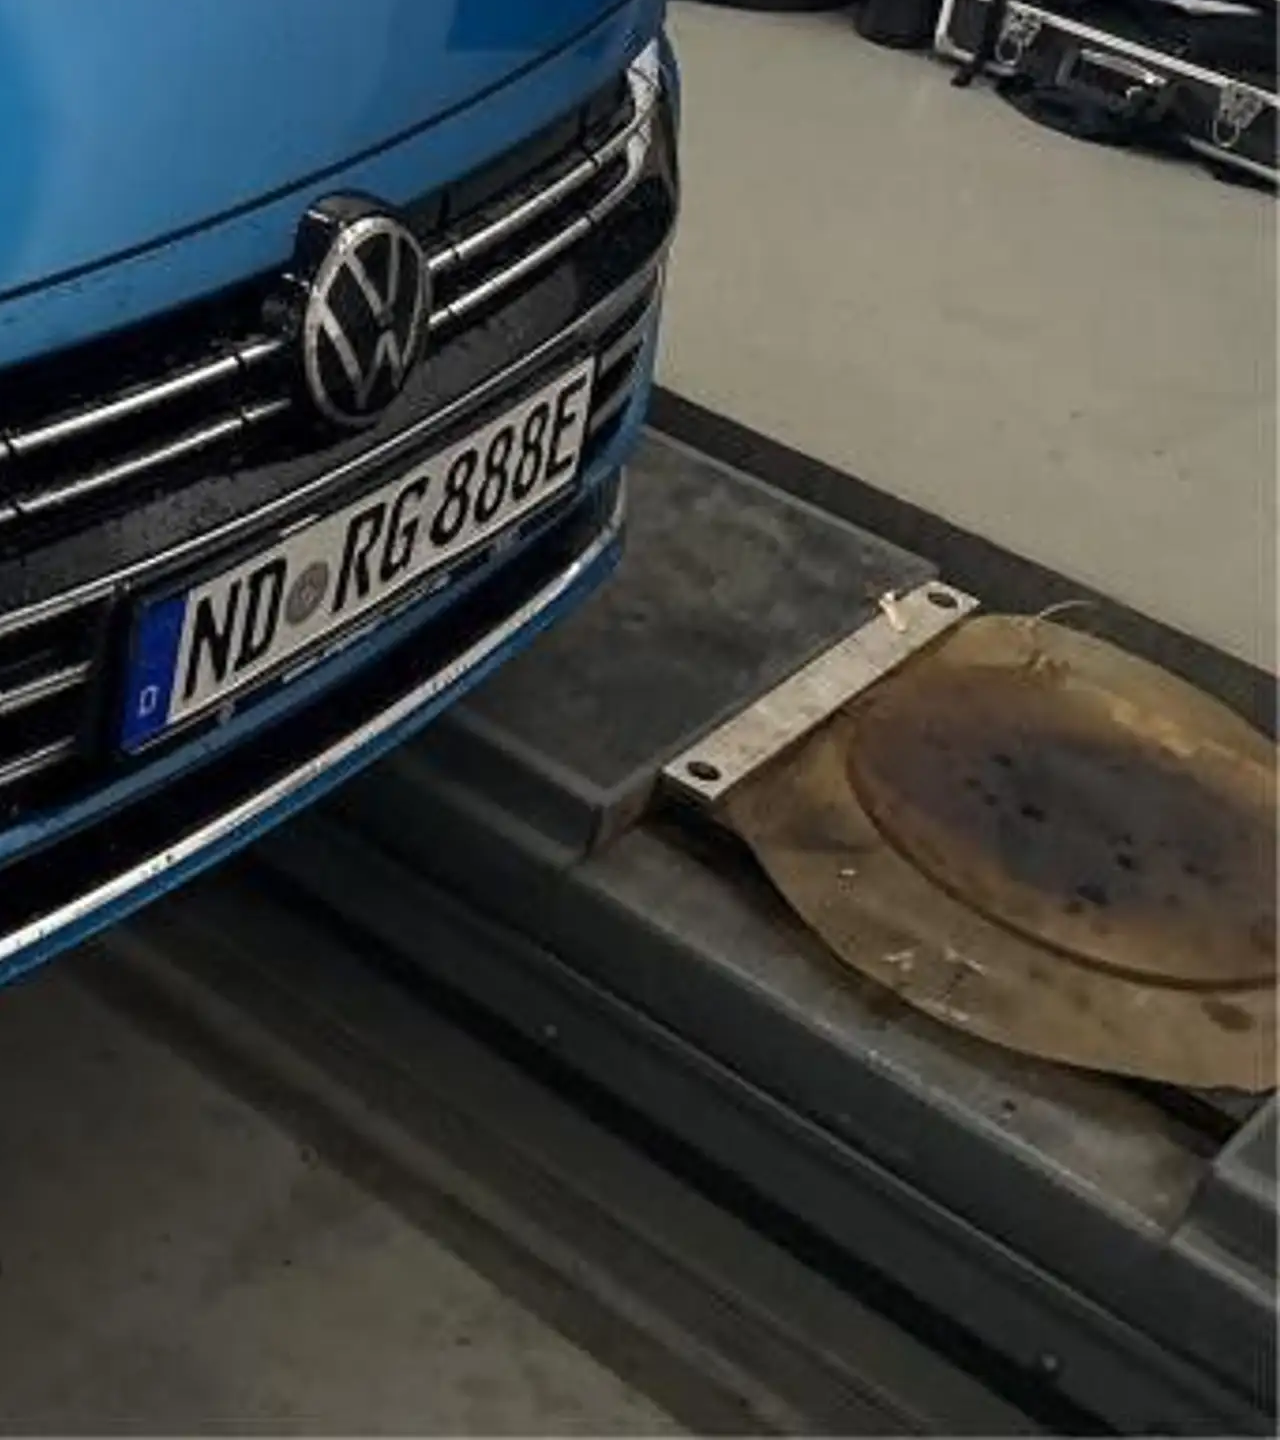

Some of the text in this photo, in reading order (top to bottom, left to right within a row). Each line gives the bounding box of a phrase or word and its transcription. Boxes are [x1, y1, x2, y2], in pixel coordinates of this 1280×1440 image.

[306, 217, 430, 426] VW
[183, 374, 588, 702] ND RG 888E
[138, 684, 160, 718] D
